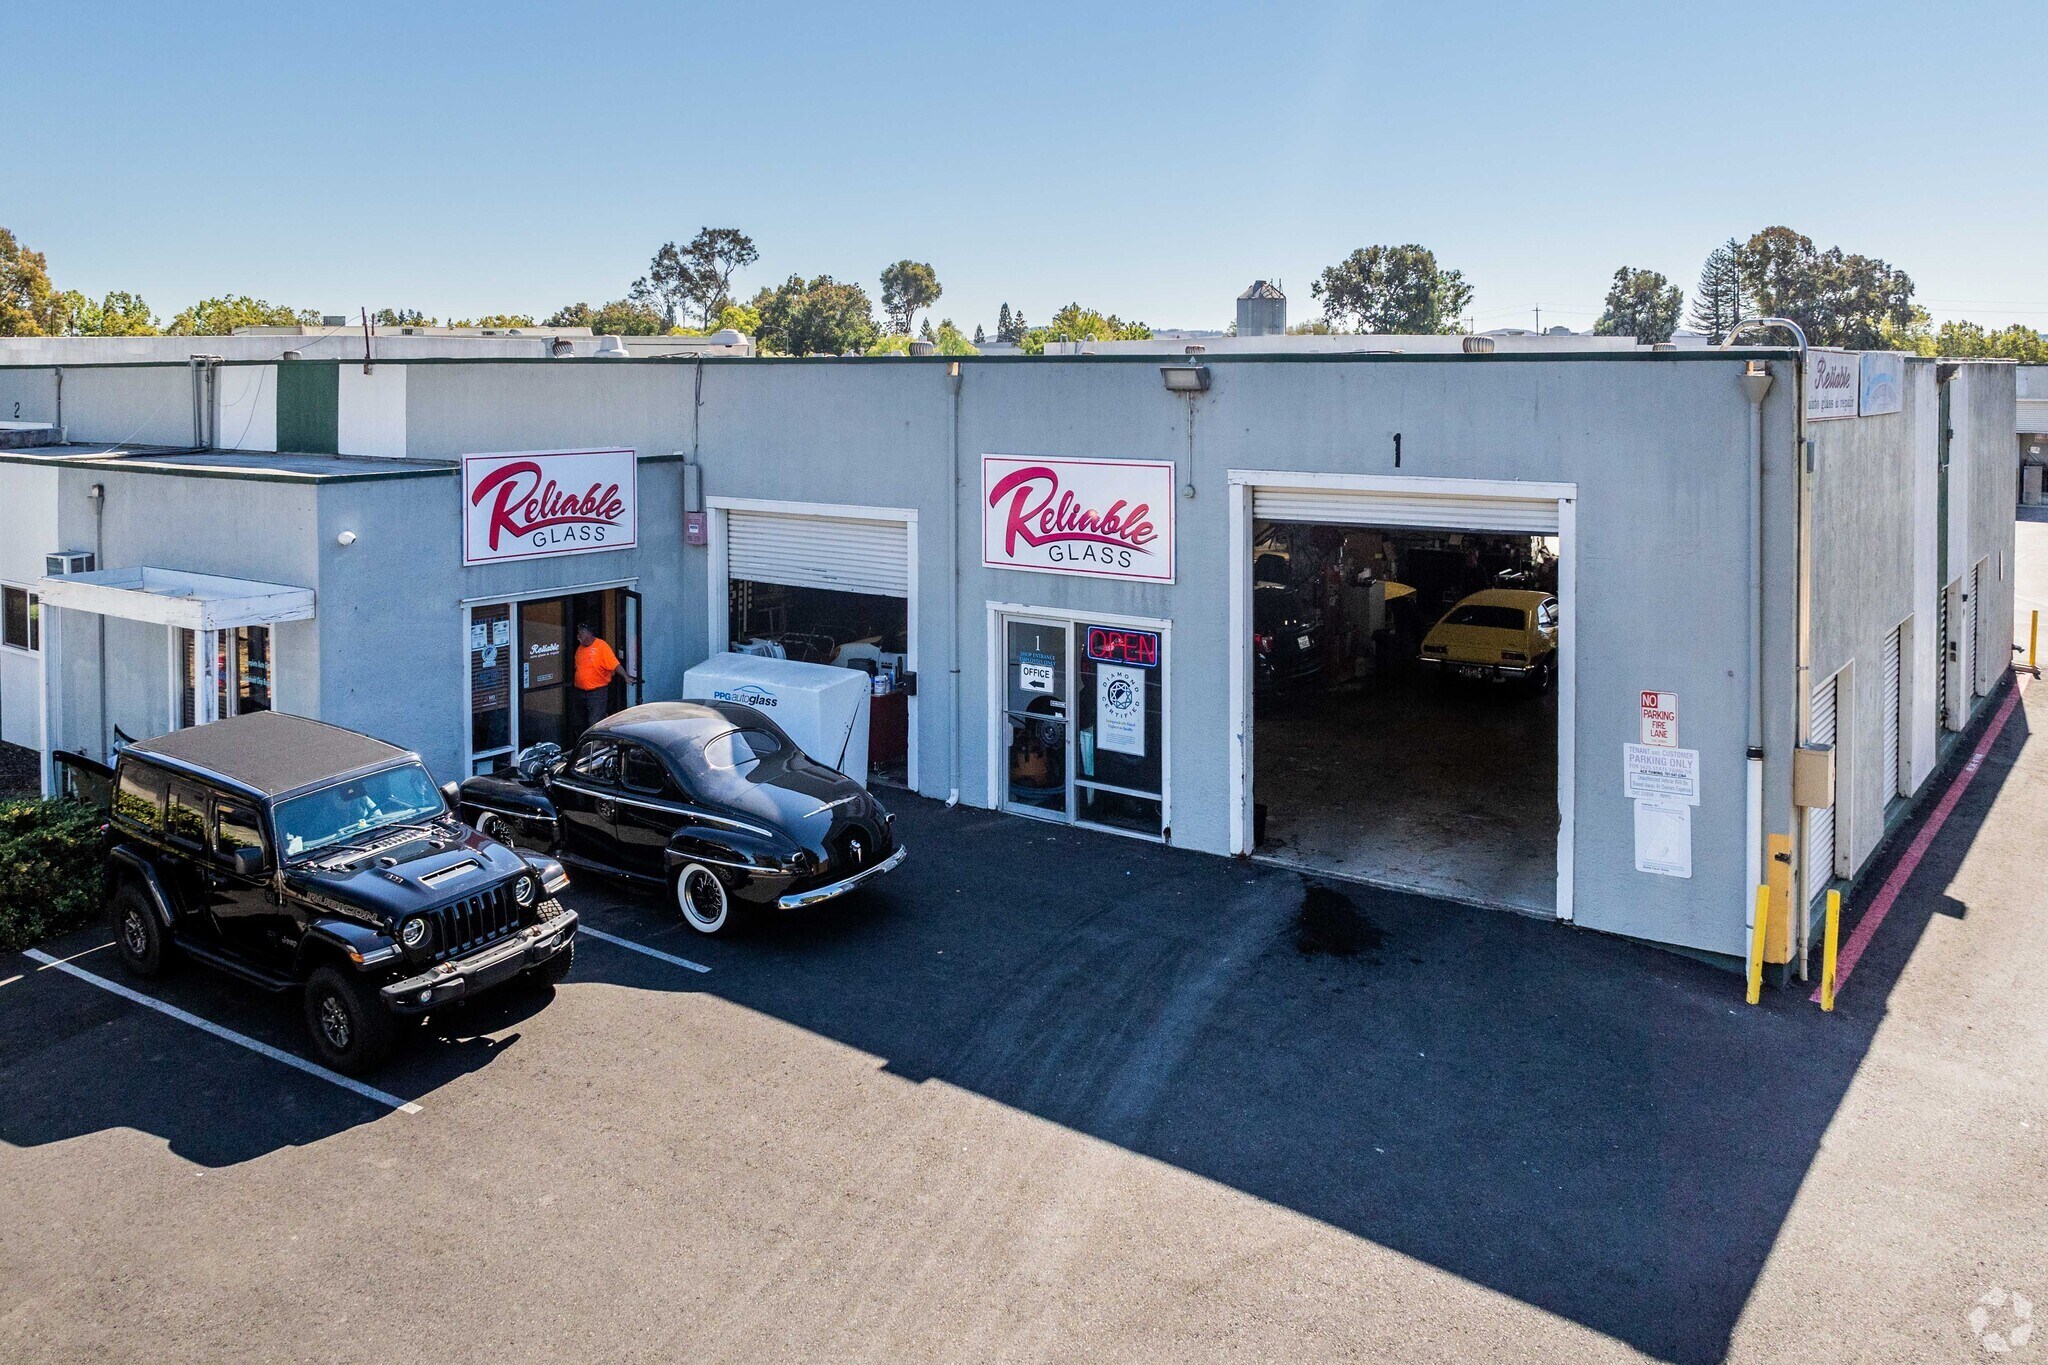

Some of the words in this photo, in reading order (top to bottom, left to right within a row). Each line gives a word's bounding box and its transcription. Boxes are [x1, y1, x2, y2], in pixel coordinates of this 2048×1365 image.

[1815, 357, 1850, 389] Reliable
[14, 402, 20, 418] 2
[1808, 398, 1819, 409] auto
[1821, 396, 1834, 412] glass
[1840, 396, 1854, 411] repair
[1393, 433, 1401, 467] 1
[472, 461, 625, 551] Reliable
[989, 467, 1158, 558] Reliable
[533, 526, 605, 547] GLASS
[1049, 544, 1132, 568] GLASS
[530, 643, 559, 655] Reliable
[1036, 635, 1040, 651] 1
[1090, 629, 1155, 663] OPEN
[1023, 667, 1049, 678] OFFICE
[1102, 672, 1139, 693] DIAMOND
[714, 692, 731, 700] PPG
[732, 693, 778, 706] autoglass
[1642, 695, 1657, 707] NO
[1102, 697, 1140, 718] CERTIFIED
[1643, 709, 1674, 721] PARKING
[1652, 720, 1666, 729] FIRE
[1650, 729, 1668, 739] LANE
[1629, 746, 1650, 755] TENANT
[1662, 750, 1694, 760] CUSTOMER
[1629, 754, 1667, 766] PARKING
[1670, 758, 1693, 769] ONLY
[306, 891, 378, 921] RUBICON
